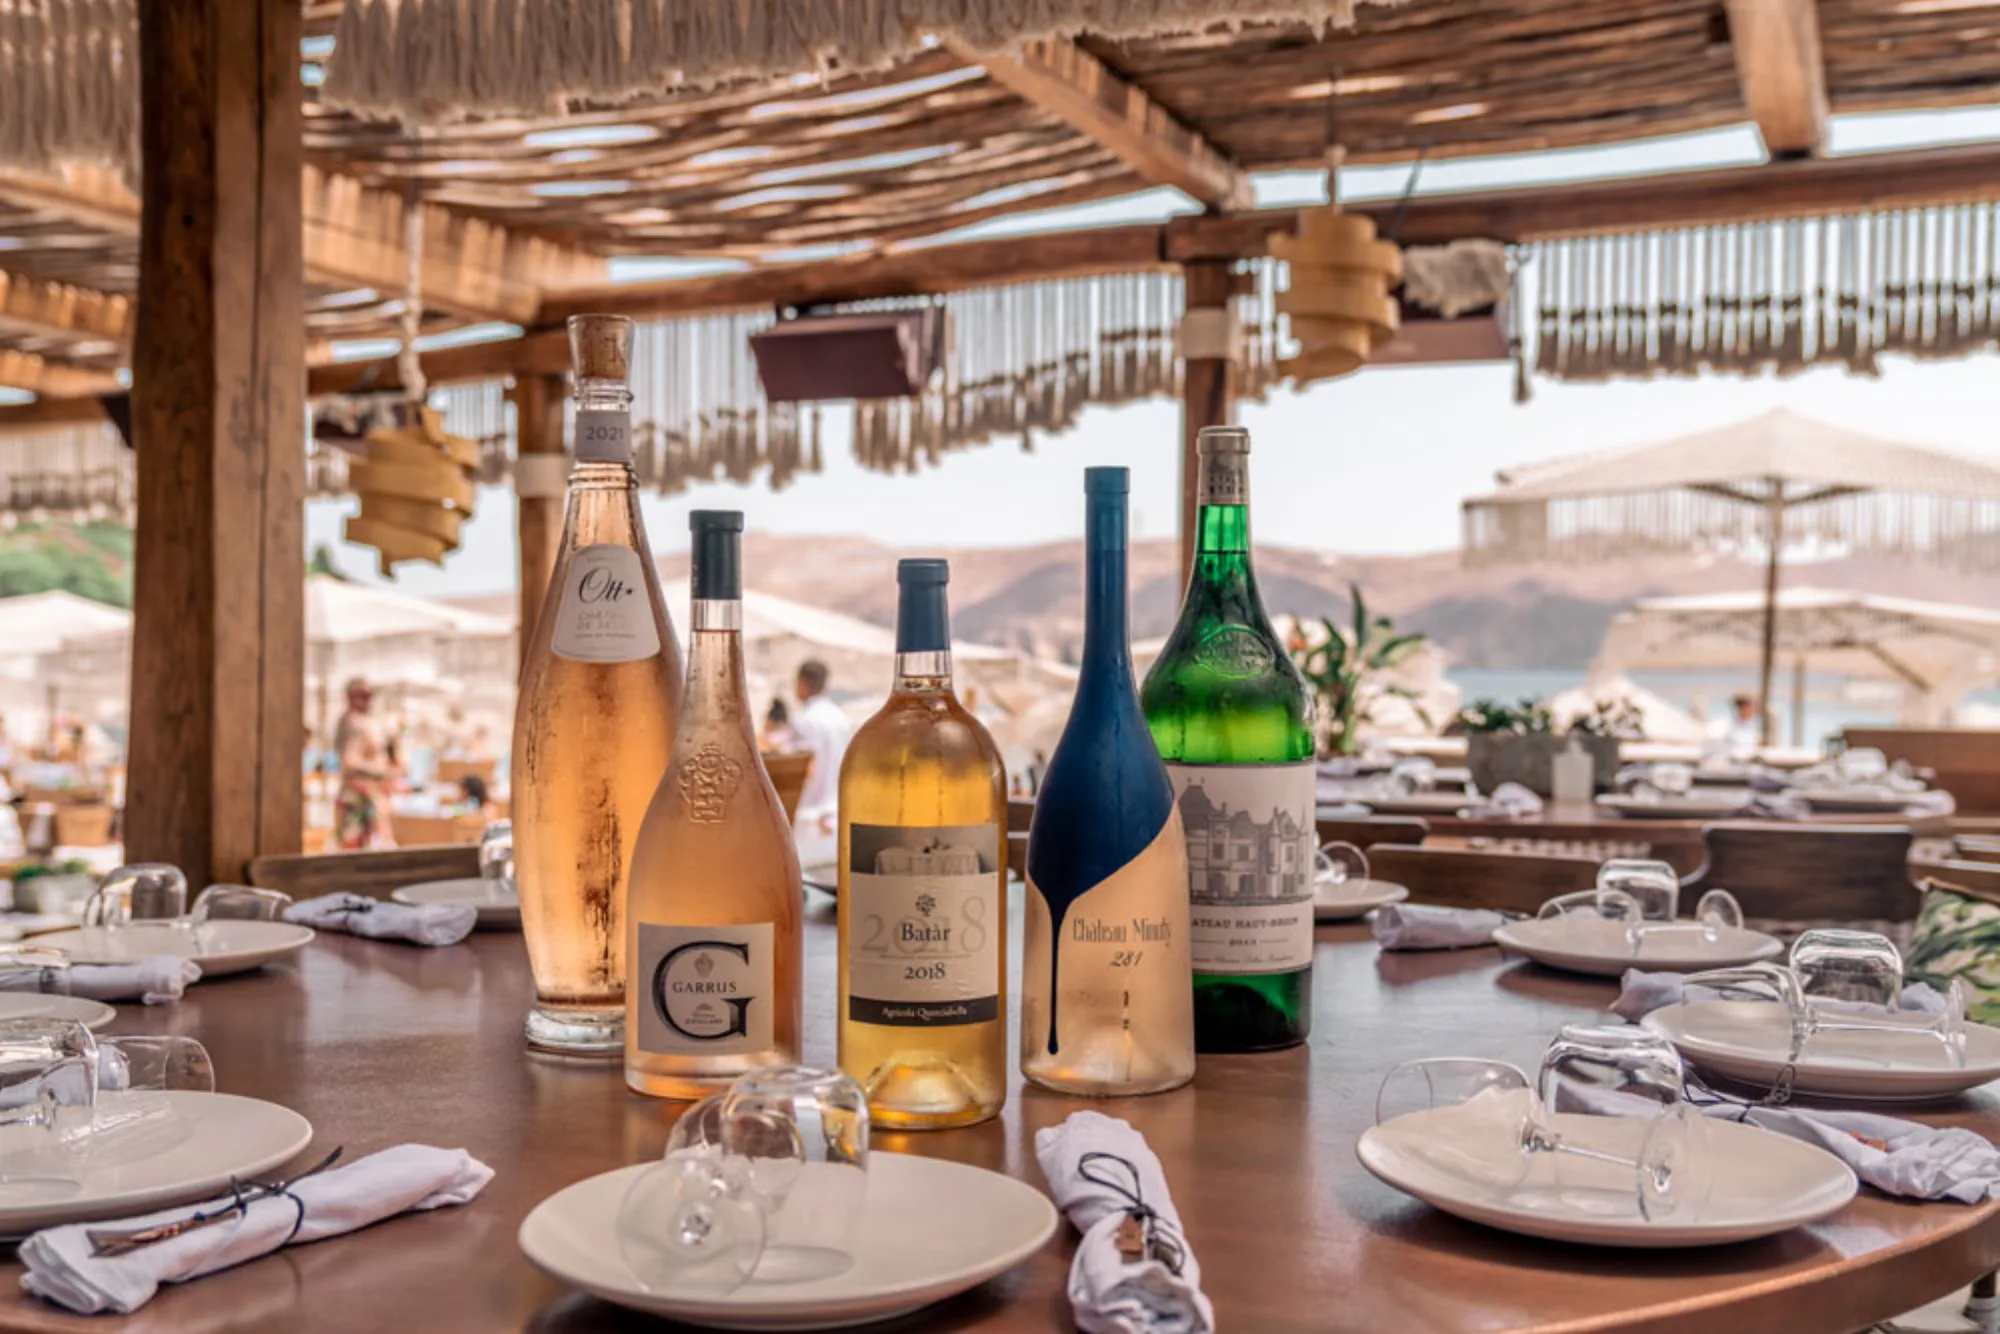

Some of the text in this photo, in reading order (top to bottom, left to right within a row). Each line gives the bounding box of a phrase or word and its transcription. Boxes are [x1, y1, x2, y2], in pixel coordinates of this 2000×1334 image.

[586, 426, 624, 440] 2021
[1191, 918, 1230, 928] ATEAU
[900, 922, 951, 941] Batàr
[904, 963, 945, 979] 2018
[652, 940, 755, 1041] G
[672, 982, 737, 993] GARRUS
